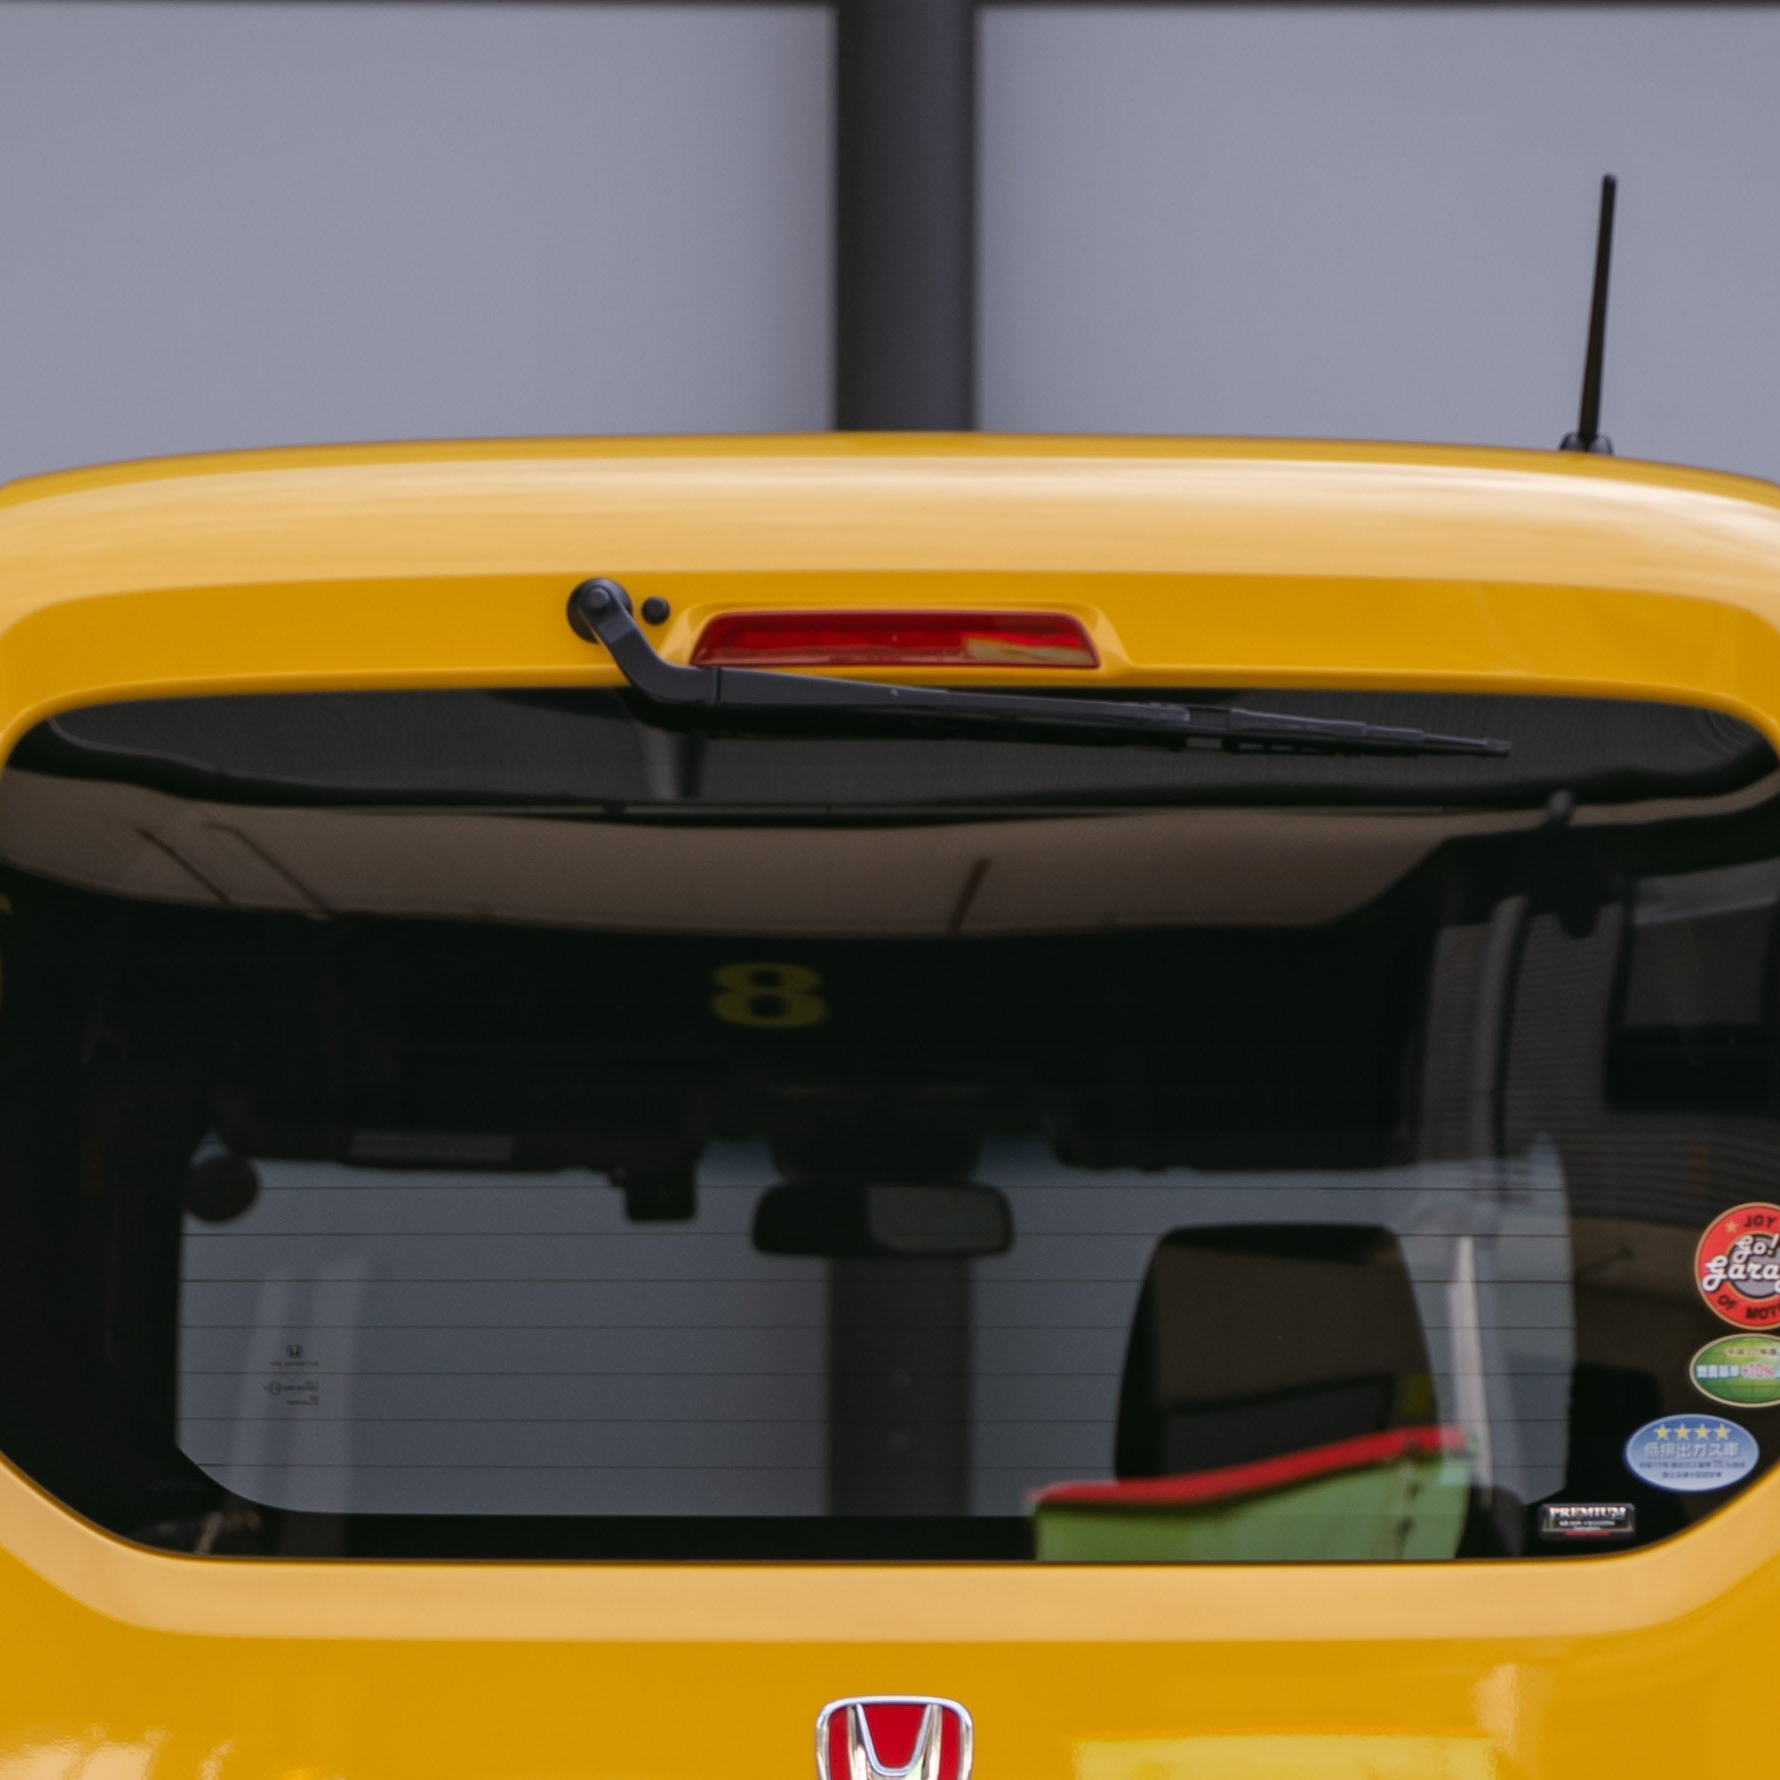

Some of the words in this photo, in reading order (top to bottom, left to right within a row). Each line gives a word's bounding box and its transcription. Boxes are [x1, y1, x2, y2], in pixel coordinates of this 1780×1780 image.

[1743, 1213, 1778, 1228] JOY
[1732, 1233, 1780, 1265] Go!
[1717, 1294, 1739, 1311] OF
[1548, 1506, 1627, 1518] PREMIUM
